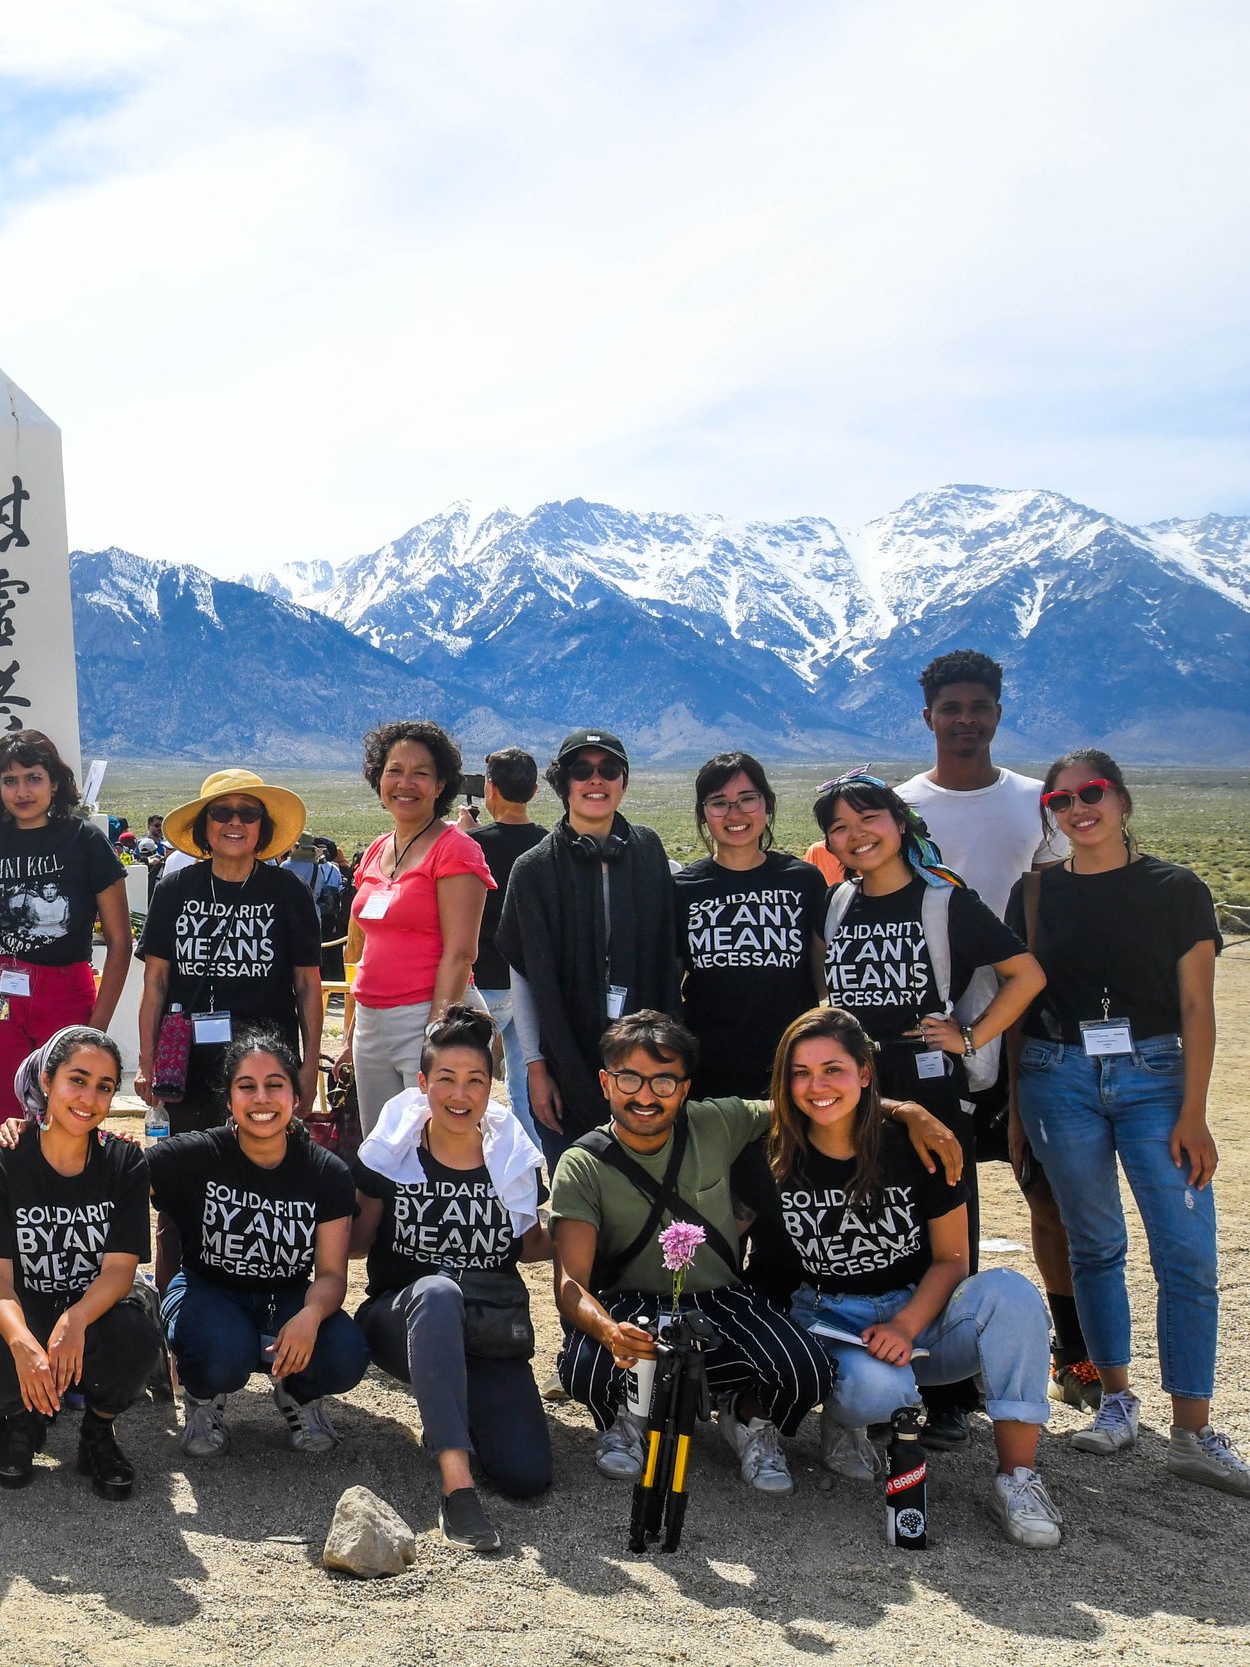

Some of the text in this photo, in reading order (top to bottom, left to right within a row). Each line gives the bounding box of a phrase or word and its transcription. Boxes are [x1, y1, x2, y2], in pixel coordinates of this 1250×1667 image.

[27, 853, 64, 876] KILL
[689, 890, 802, 915] SOLIDARITY
[175, 914, 275, 937] BY ANY
[688, 904, 803, 930] BY ANY
[175, 938, 275, 961] MEANS
[688, 927, 803, 954] MEANS
[855, 938, 926, 962] ANY
[178, 962, 273, 977] NECESSARY
[692, 952, 801, 969] NECESSARY
[205, 1181, 316, 1218] SOLIDARITY
[394, 1196, 509, 1225] BY ANY
[203, 1198, 316, 1247] BY ANY
[782, 1202, 916, 1237] BY ANY
[16, 1225, 58, 1253] BY
[201, 1224, 314, 1265] MEANS
[394, 1219, 512, 1254] MEANS
[392, 1240, 509, 1269] NECESSARY
